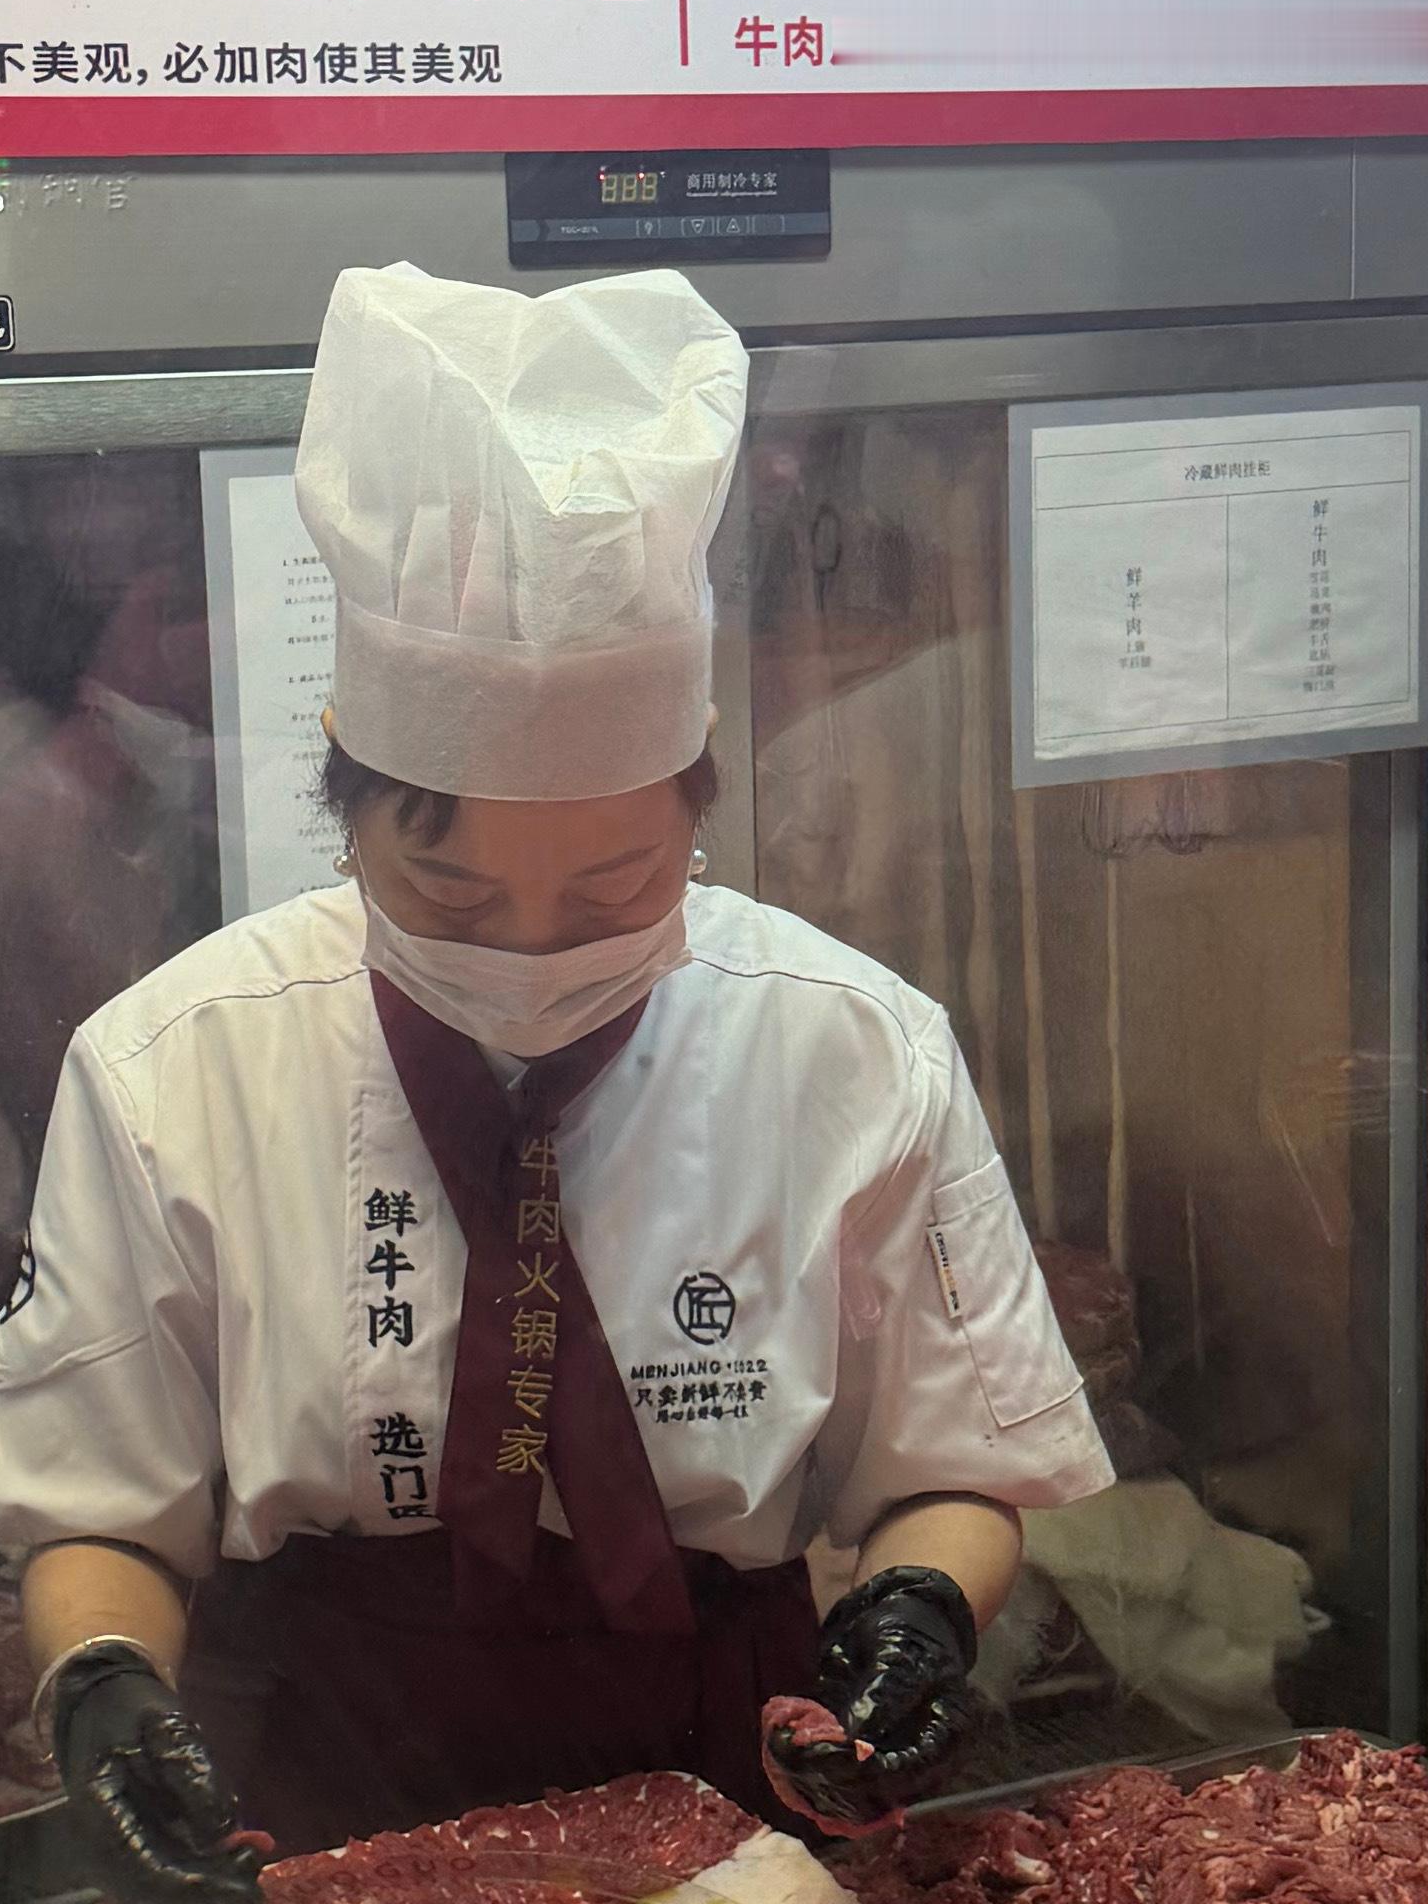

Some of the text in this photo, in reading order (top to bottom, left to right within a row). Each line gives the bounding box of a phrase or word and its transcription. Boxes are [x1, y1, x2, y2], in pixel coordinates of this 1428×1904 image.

[363, 1187, 419, 1349] 鲜牛肉
[496, 1134, 561, 1476] 牛肉火锅专家
